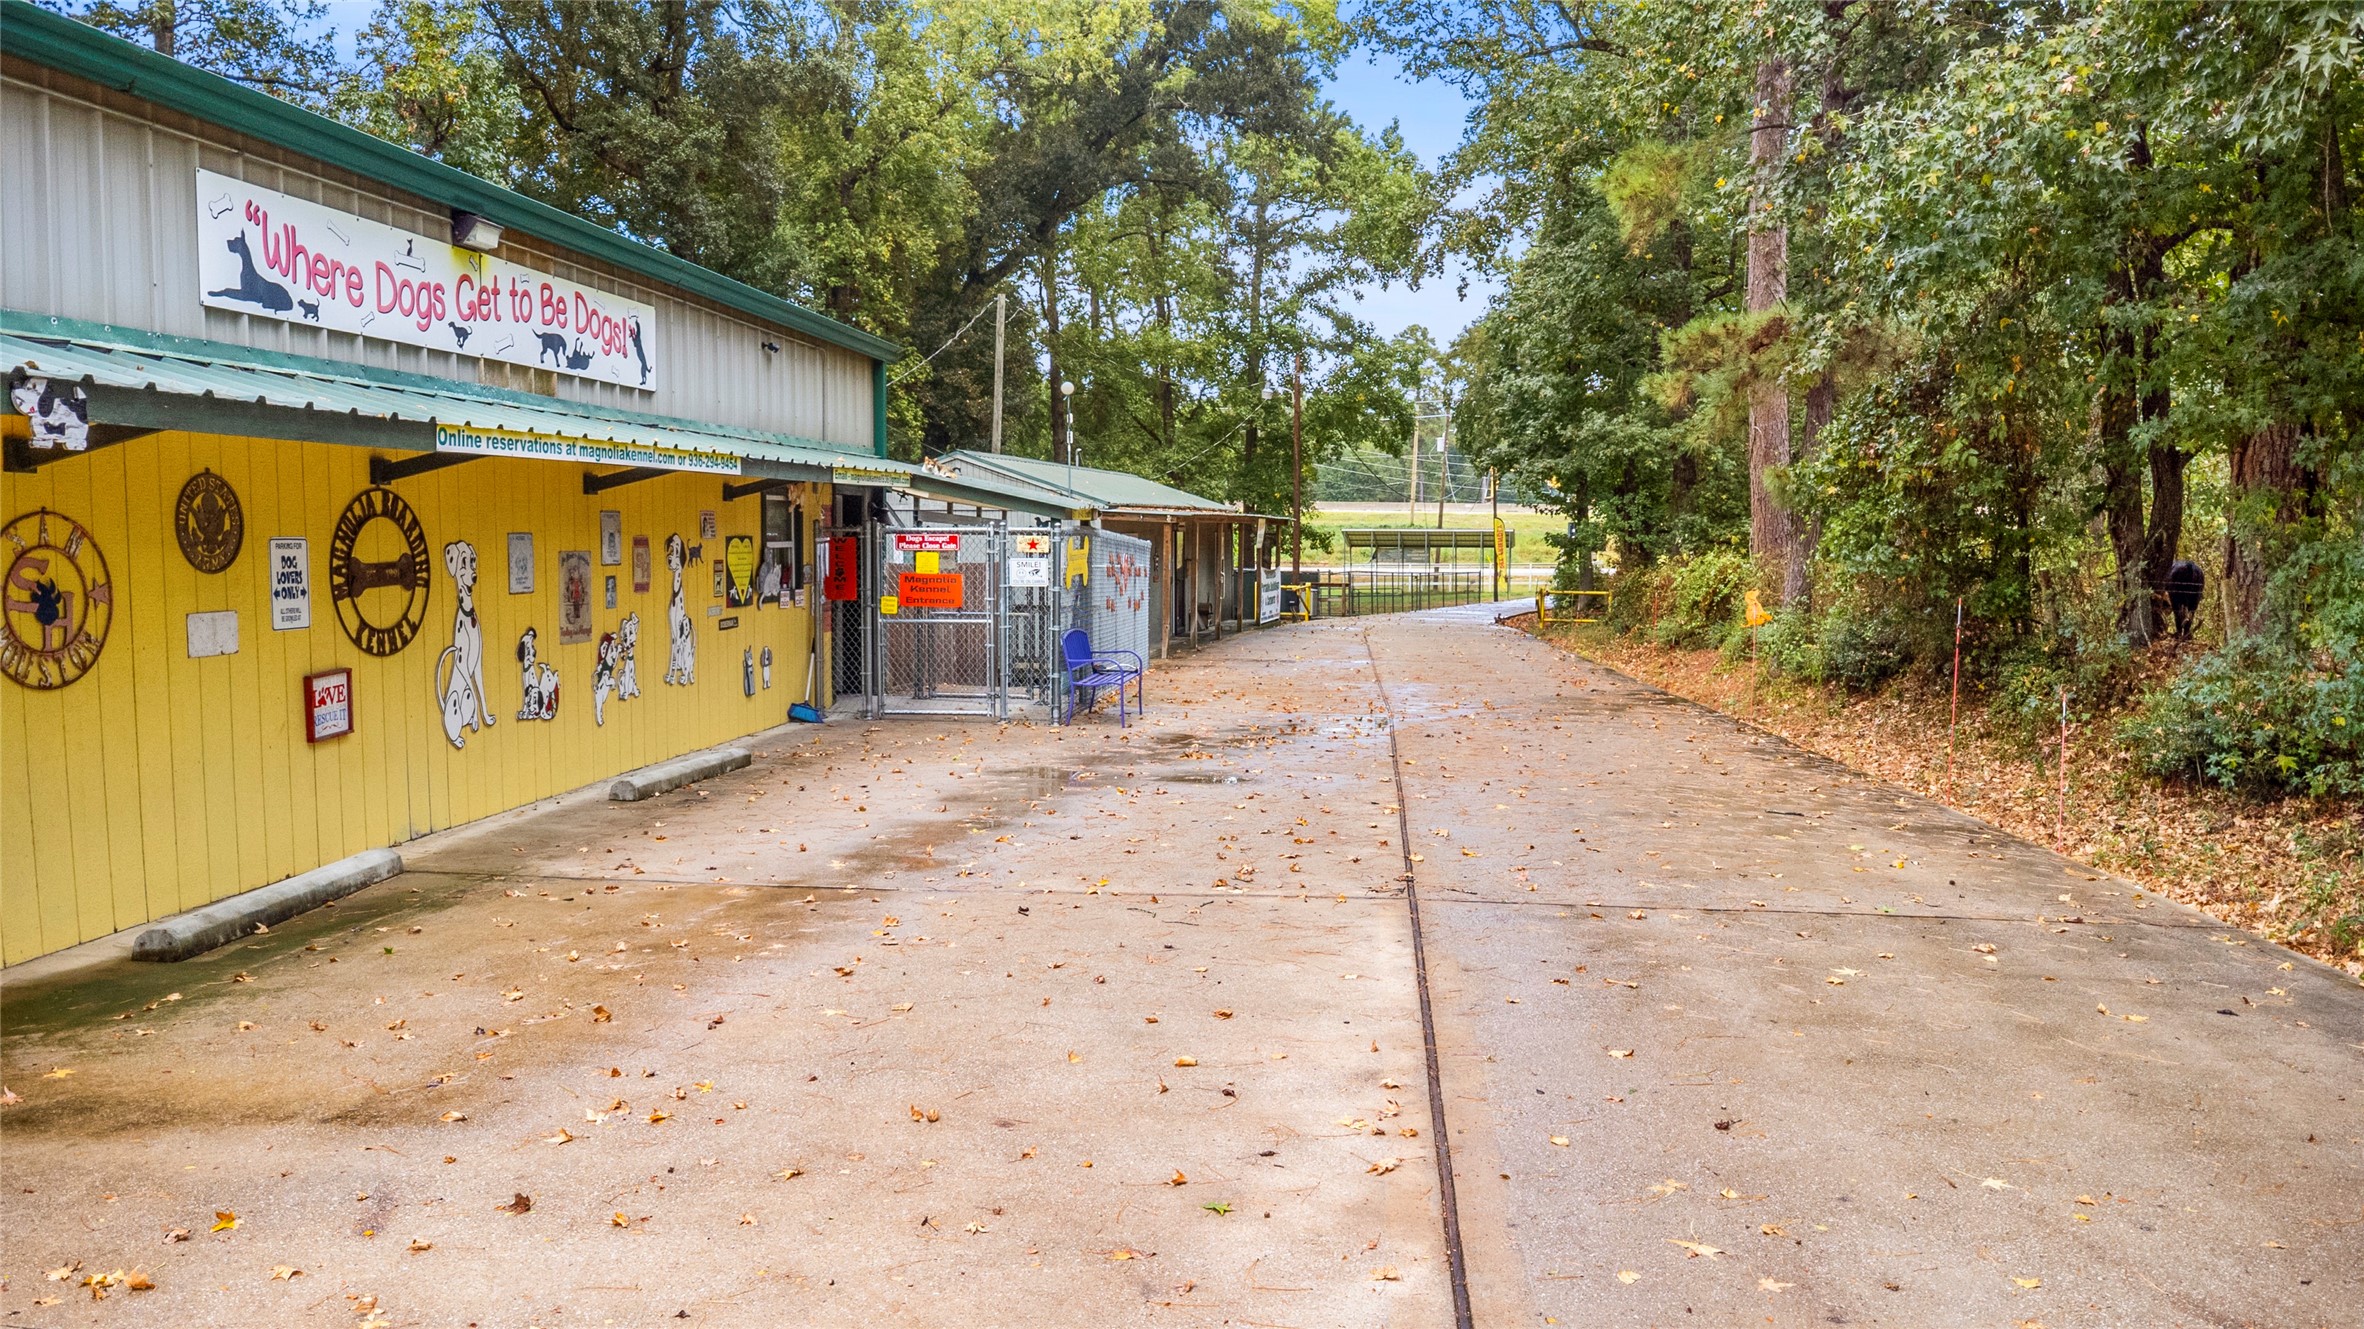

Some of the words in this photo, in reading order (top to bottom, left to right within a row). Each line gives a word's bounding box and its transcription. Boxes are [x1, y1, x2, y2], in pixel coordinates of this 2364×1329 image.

[375, 260, 446, 332] Dogs
[455, 273, 502, 322] Get
[509, 276, 533, 323] to
[540, 282, 568, 329] Be
[437, 426, 482, 449] Online
[486, 436, 563, 456] reservations
[566, 441, 577, 456] at
[579, 444, 676, 466] magnoliakennel.com
[677, 456, 686, 466] or
[688, 453, 738, 471] 936-294-9454
[905, 535, 923, 544] Dogs
[924, 535, 950, 544] Escape!
[281, 555, 298, 569] DOG
[276, 570, 303, 585] LOVERS
[904, 576, 957, 585] Magnolia
[281, 586, 300, 600] ONLY
[910, 585, 951, 593] Kennel
[905, 596, 955, 605] Entrance
[354, 613, 419, 656] KENNEL
